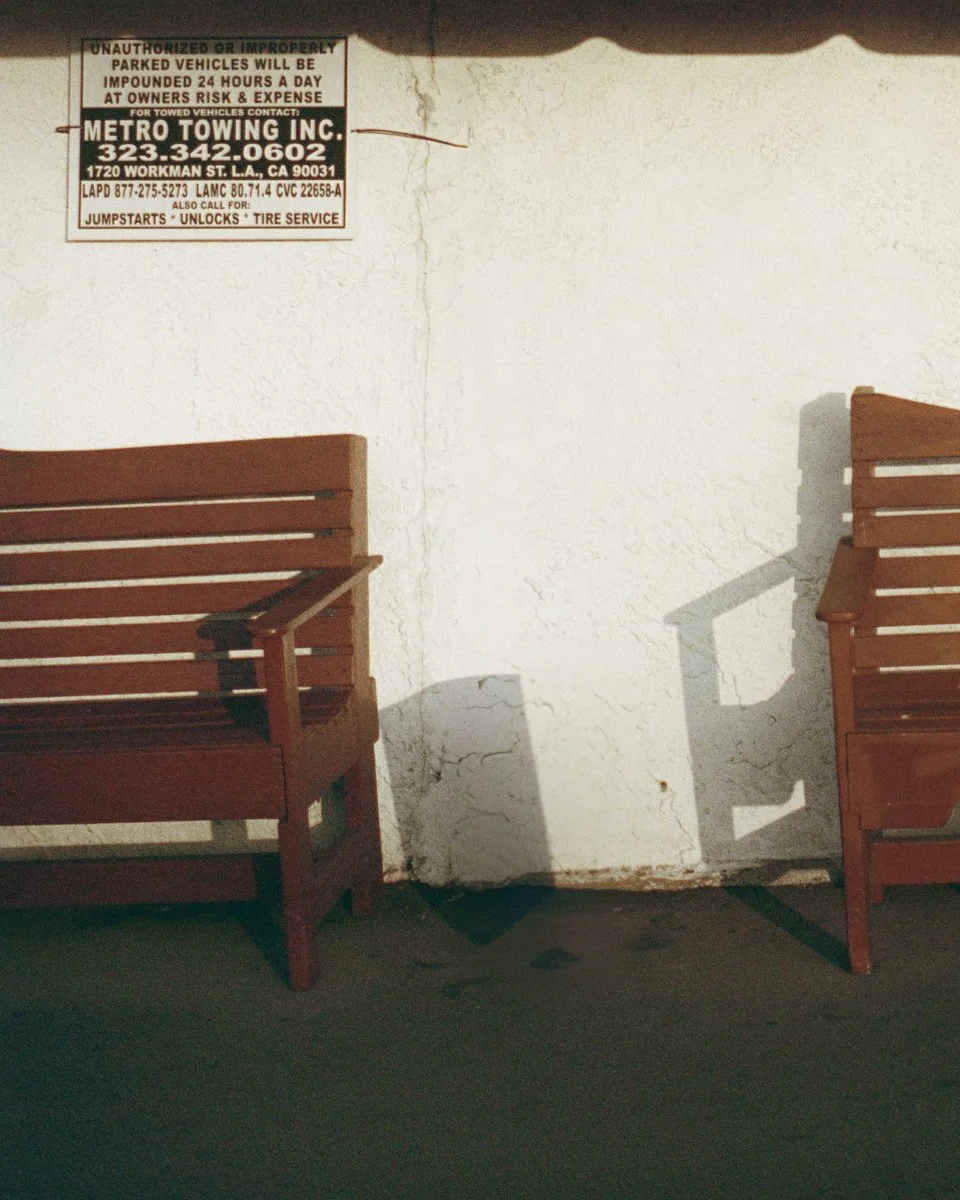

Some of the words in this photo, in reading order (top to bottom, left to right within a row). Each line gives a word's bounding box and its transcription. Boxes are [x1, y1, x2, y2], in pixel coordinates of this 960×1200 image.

[91, 42, 208, 55] UNAUTHORIZED
[215, 42, 234, 54] OR
[241, 41, 336, 54] IMPROPERLY
[112, 59, 170, 71] PARKED
[177, 58, 248, 70] VEHICLES
[255, 58, 290, 70] WILL
[297, 58, 315, 70] BE
[104, 75, 191, 88] IMPOUNDED
[197, 75, 215, 88] 24
[221, 75, 272, 88] HOURS
[279, 75, 288, 88] A
[294, 75, 322, 88] DAY
[104, 92, 122, 104] AT
[128, 91, 190, 104] OWNERS
[197, 91, 231, 104] RISK
[238, 91, 247, 103] &
[255, 91, 322, 104] EXPENSE
[130, 108, 150, 117] FOR
[154, 108, 190, 117] TOWED
[193, 108, 244, 117] VEHICLES
[247, 108, 300, 117] CONTACT:
[84, 119, 169, 141] METRO
[179, 119, 278, 141] TOWING
[290, 119, 342, 141] INC.
[98, 143, 326, 161] 323.342.0602
[87, 165, 120, 178] 1720
[125, 165, 201, 178] WORKMAN
[206, 165, 226, 178] ST.
[232, 165, 263, 179] L.A.,
[267, 165, 288, 178] CA
[293, 165, 335, 178] 90031
[82, 183, 111, 198] LAPD
[114, 183, 188, 198] 877-275-5273
[196, 183, 226, 198] LAMC
[231, 183, 271, 197] 80.71.4
[276, 183, 297, 198] CVC
[300, 182, 341, 197] 22658-A
[172, 201, 197, 209] ALSO
[200, 201, 226, 209] CALL
[228, 201, 250, 209] FOR:
[85, 212, 166, 225] JUMPSTARTS
[180, 212, 239, 225] UNLOCKS
[253, 212, 283, 225] TIRE
[285, 212, 339, 225] SERVICE
